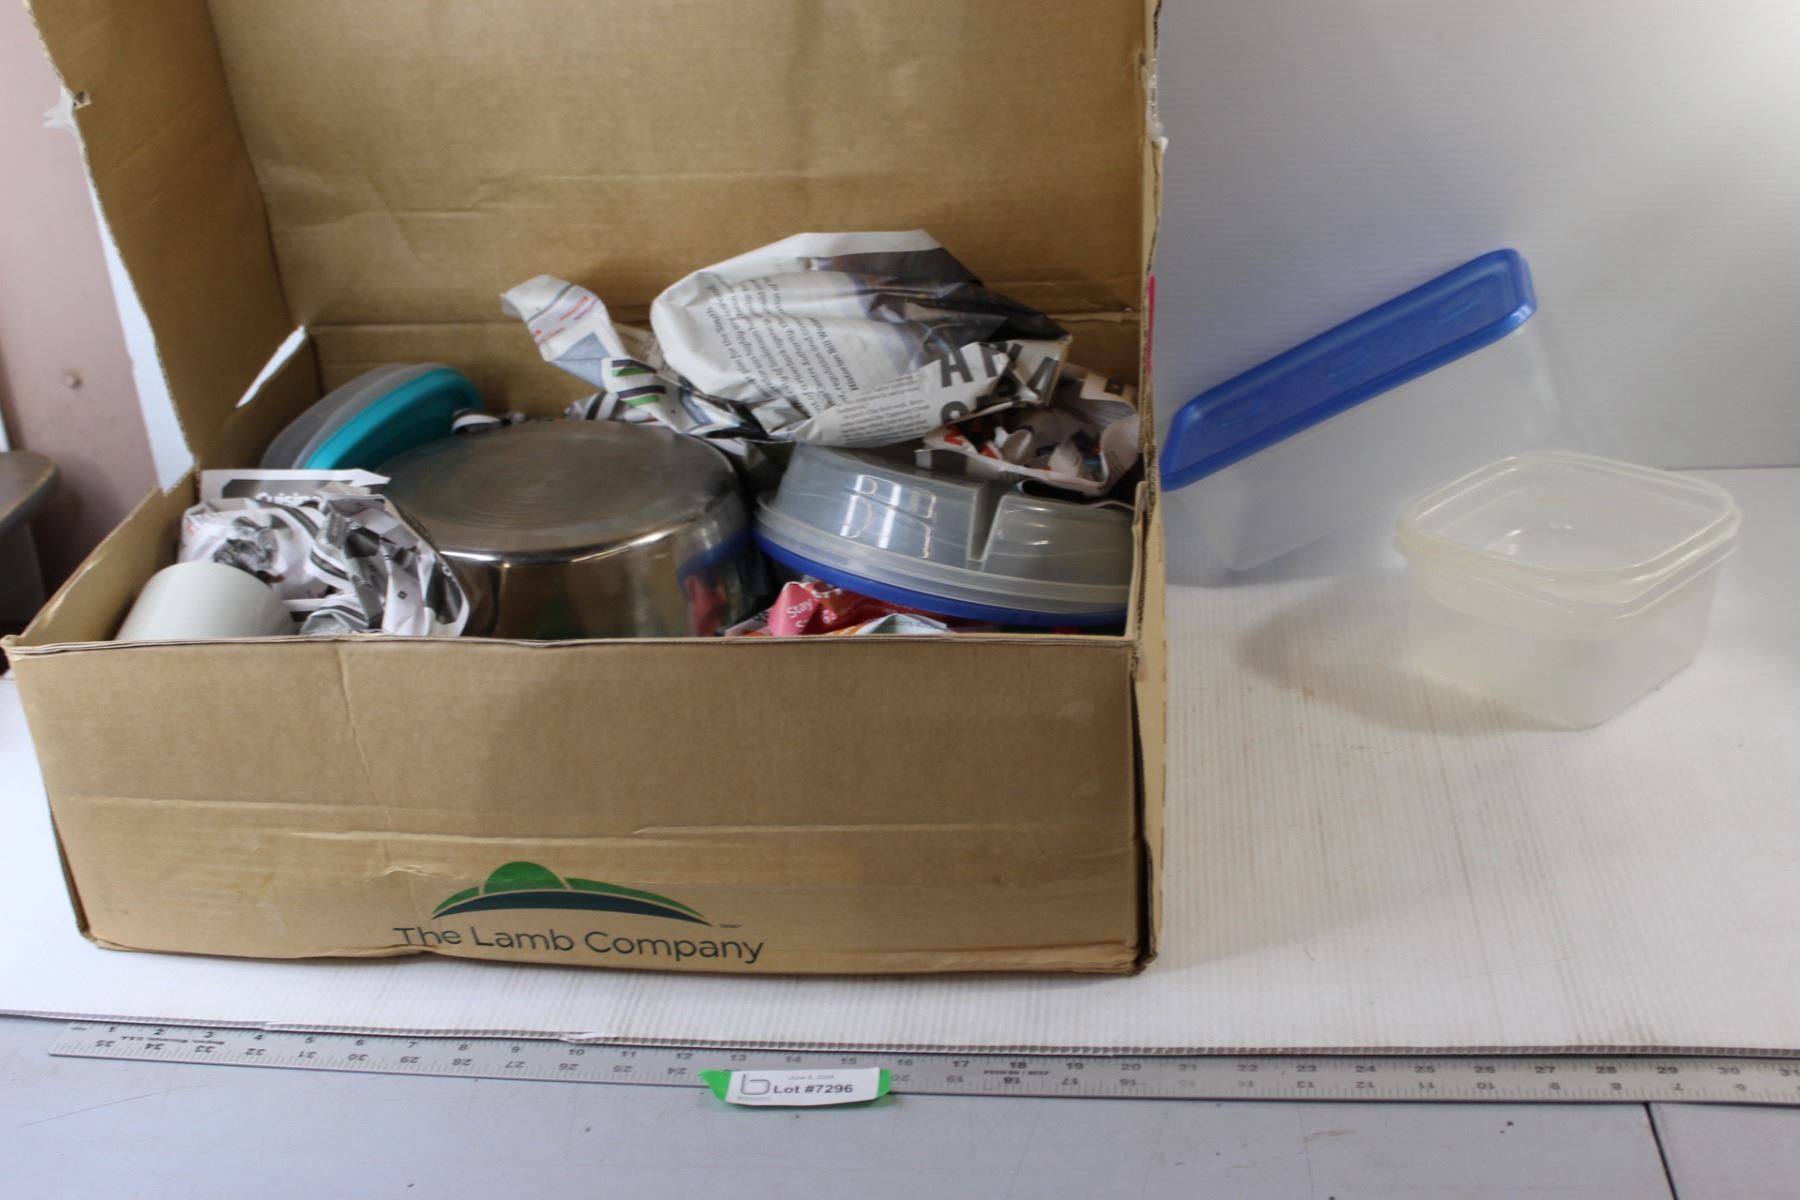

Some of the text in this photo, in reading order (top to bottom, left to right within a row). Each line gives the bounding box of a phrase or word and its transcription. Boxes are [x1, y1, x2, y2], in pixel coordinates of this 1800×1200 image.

[701, 306, 727, 333] South
[820, 339, 838, 353] Bill
[829, 353, 860, 391] Historian
[787, 599, 813, 619] Stay
[393, 926, 764, 963] The Lamb Company
[304, 1036, 315, 1044] 5
[568, 1048, 585, 1056] 10
[676, 1051, 693, 1059] 12
[785, 1055, 802, 1063] 14
[840, 1057, 858, 1065] 15
[896, 1058, 913, 1066] 16
[953, 1060, 970, 1068] 17
[1009, 1061, 1027, 1069] 18
[1066, 1062, 1084, 1070] 19
[1120, 1063, 1142, 1071] 20
[1178, 1063, 1197, 1072] 21
[1237, 1064, 1259, 1072] 22
[1296, 1064, 1317, 1073] 23
[1355, 1064, 1377, 1073] 24
[1415, 1064, 1437, 1073] 25
[1473, 1065, 1496, 1074] 26
[1534, 1065, 1556, 1074] 27
[1595, 1066, 1618, 1074] 28
[1656, 1066, 1679, 1074] 29
[1717, 1066, 1741, 1075] 30
[773, 1084, 853, 1094] Lot #7296
